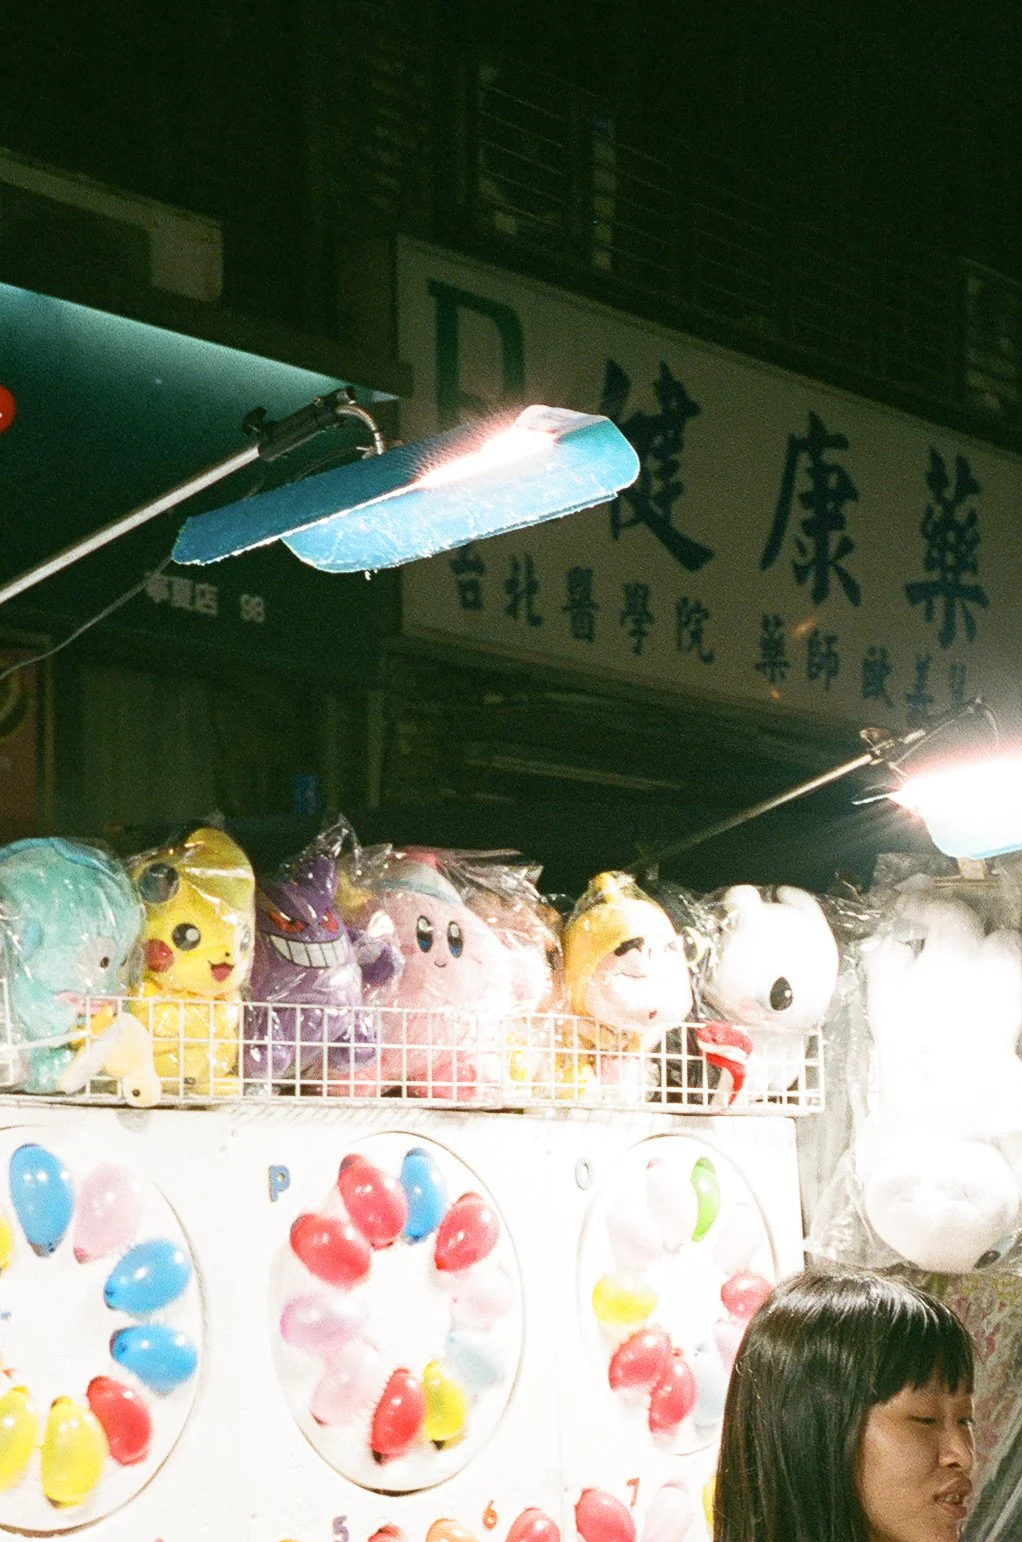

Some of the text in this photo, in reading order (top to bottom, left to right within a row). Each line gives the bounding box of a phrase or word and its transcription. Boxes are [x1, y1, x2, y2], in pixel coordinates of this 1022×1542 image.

[449, 543, 715, 664] 台北醫學院
[755, 613, 840, 691] 藥師
[267, 1164, 292, 1202] P
[482, 1499, 498, 1530] 6
